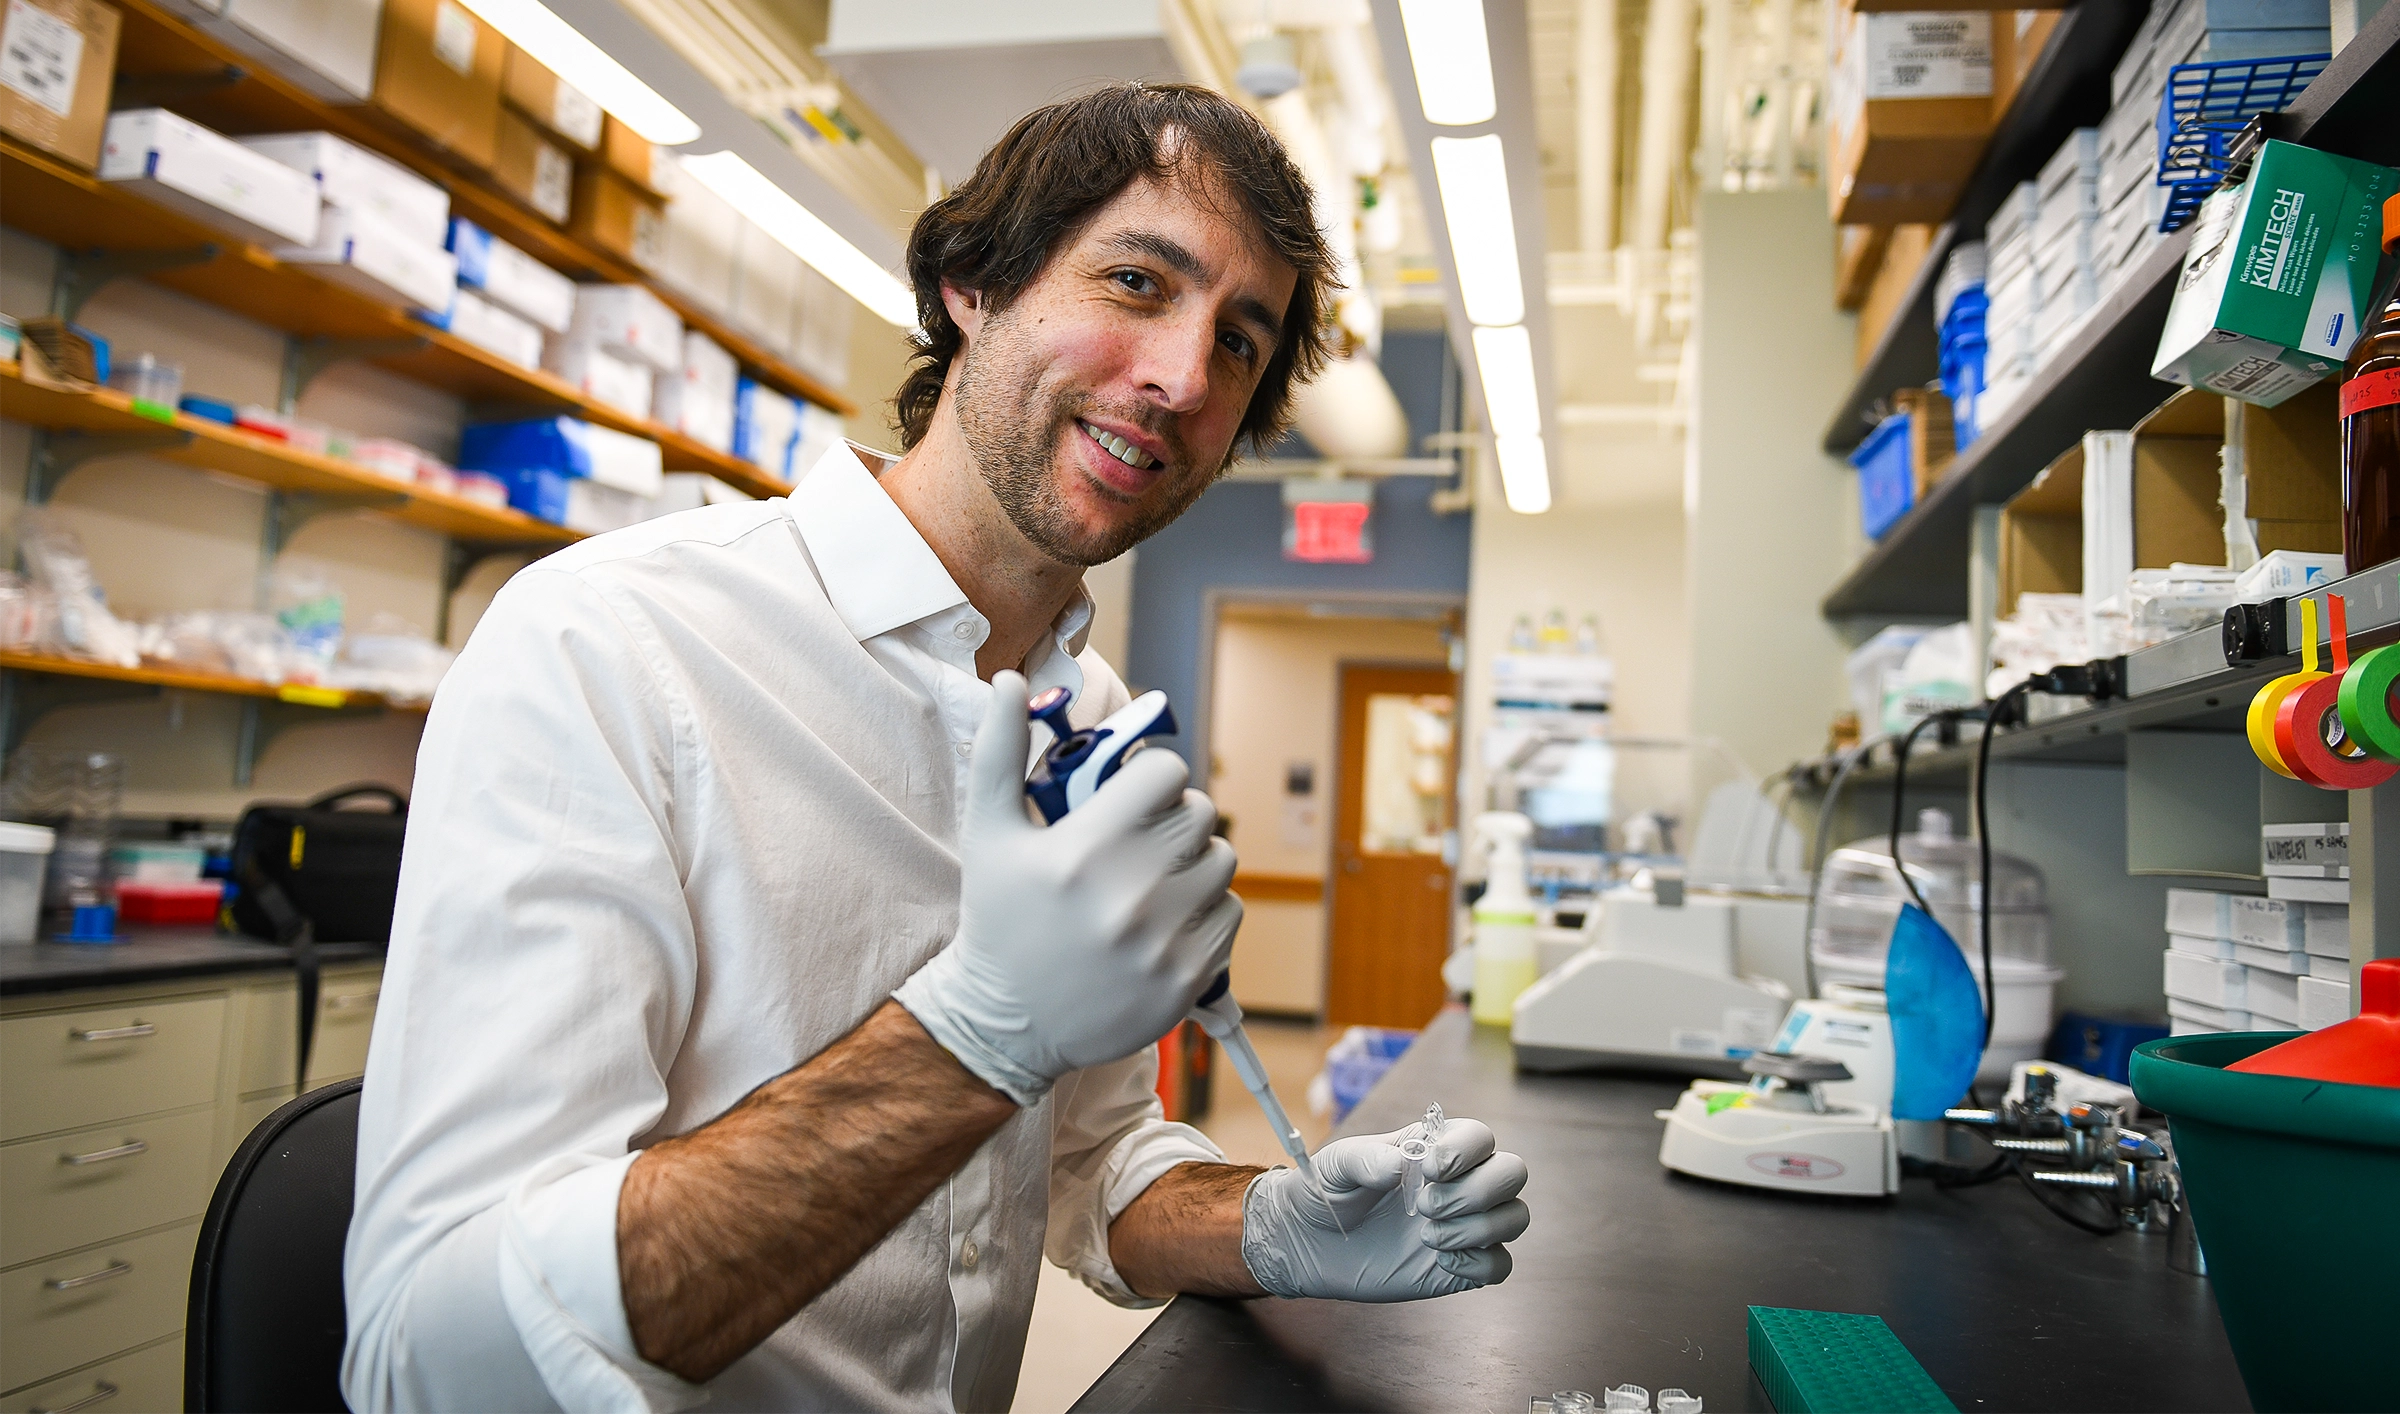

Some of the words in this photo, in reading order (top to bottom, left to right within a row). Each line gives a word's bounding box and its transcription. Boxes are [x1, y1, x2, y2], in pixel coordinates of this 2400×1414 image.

[2249, 188, 2294, 287] KIMTECH
[2284, 213, 2297, 240] SCIENCE
[2239, 244, 2257, 282] Kimwipes
[2278, 270, 2290, 293] Delicate
[2285, 259, 2293, 270] Task
[2289, 240, 2299, 258] Wipers
[2303, 252, 2313, 268] tareas
[2308, 227, 2320, 252] delicadas
